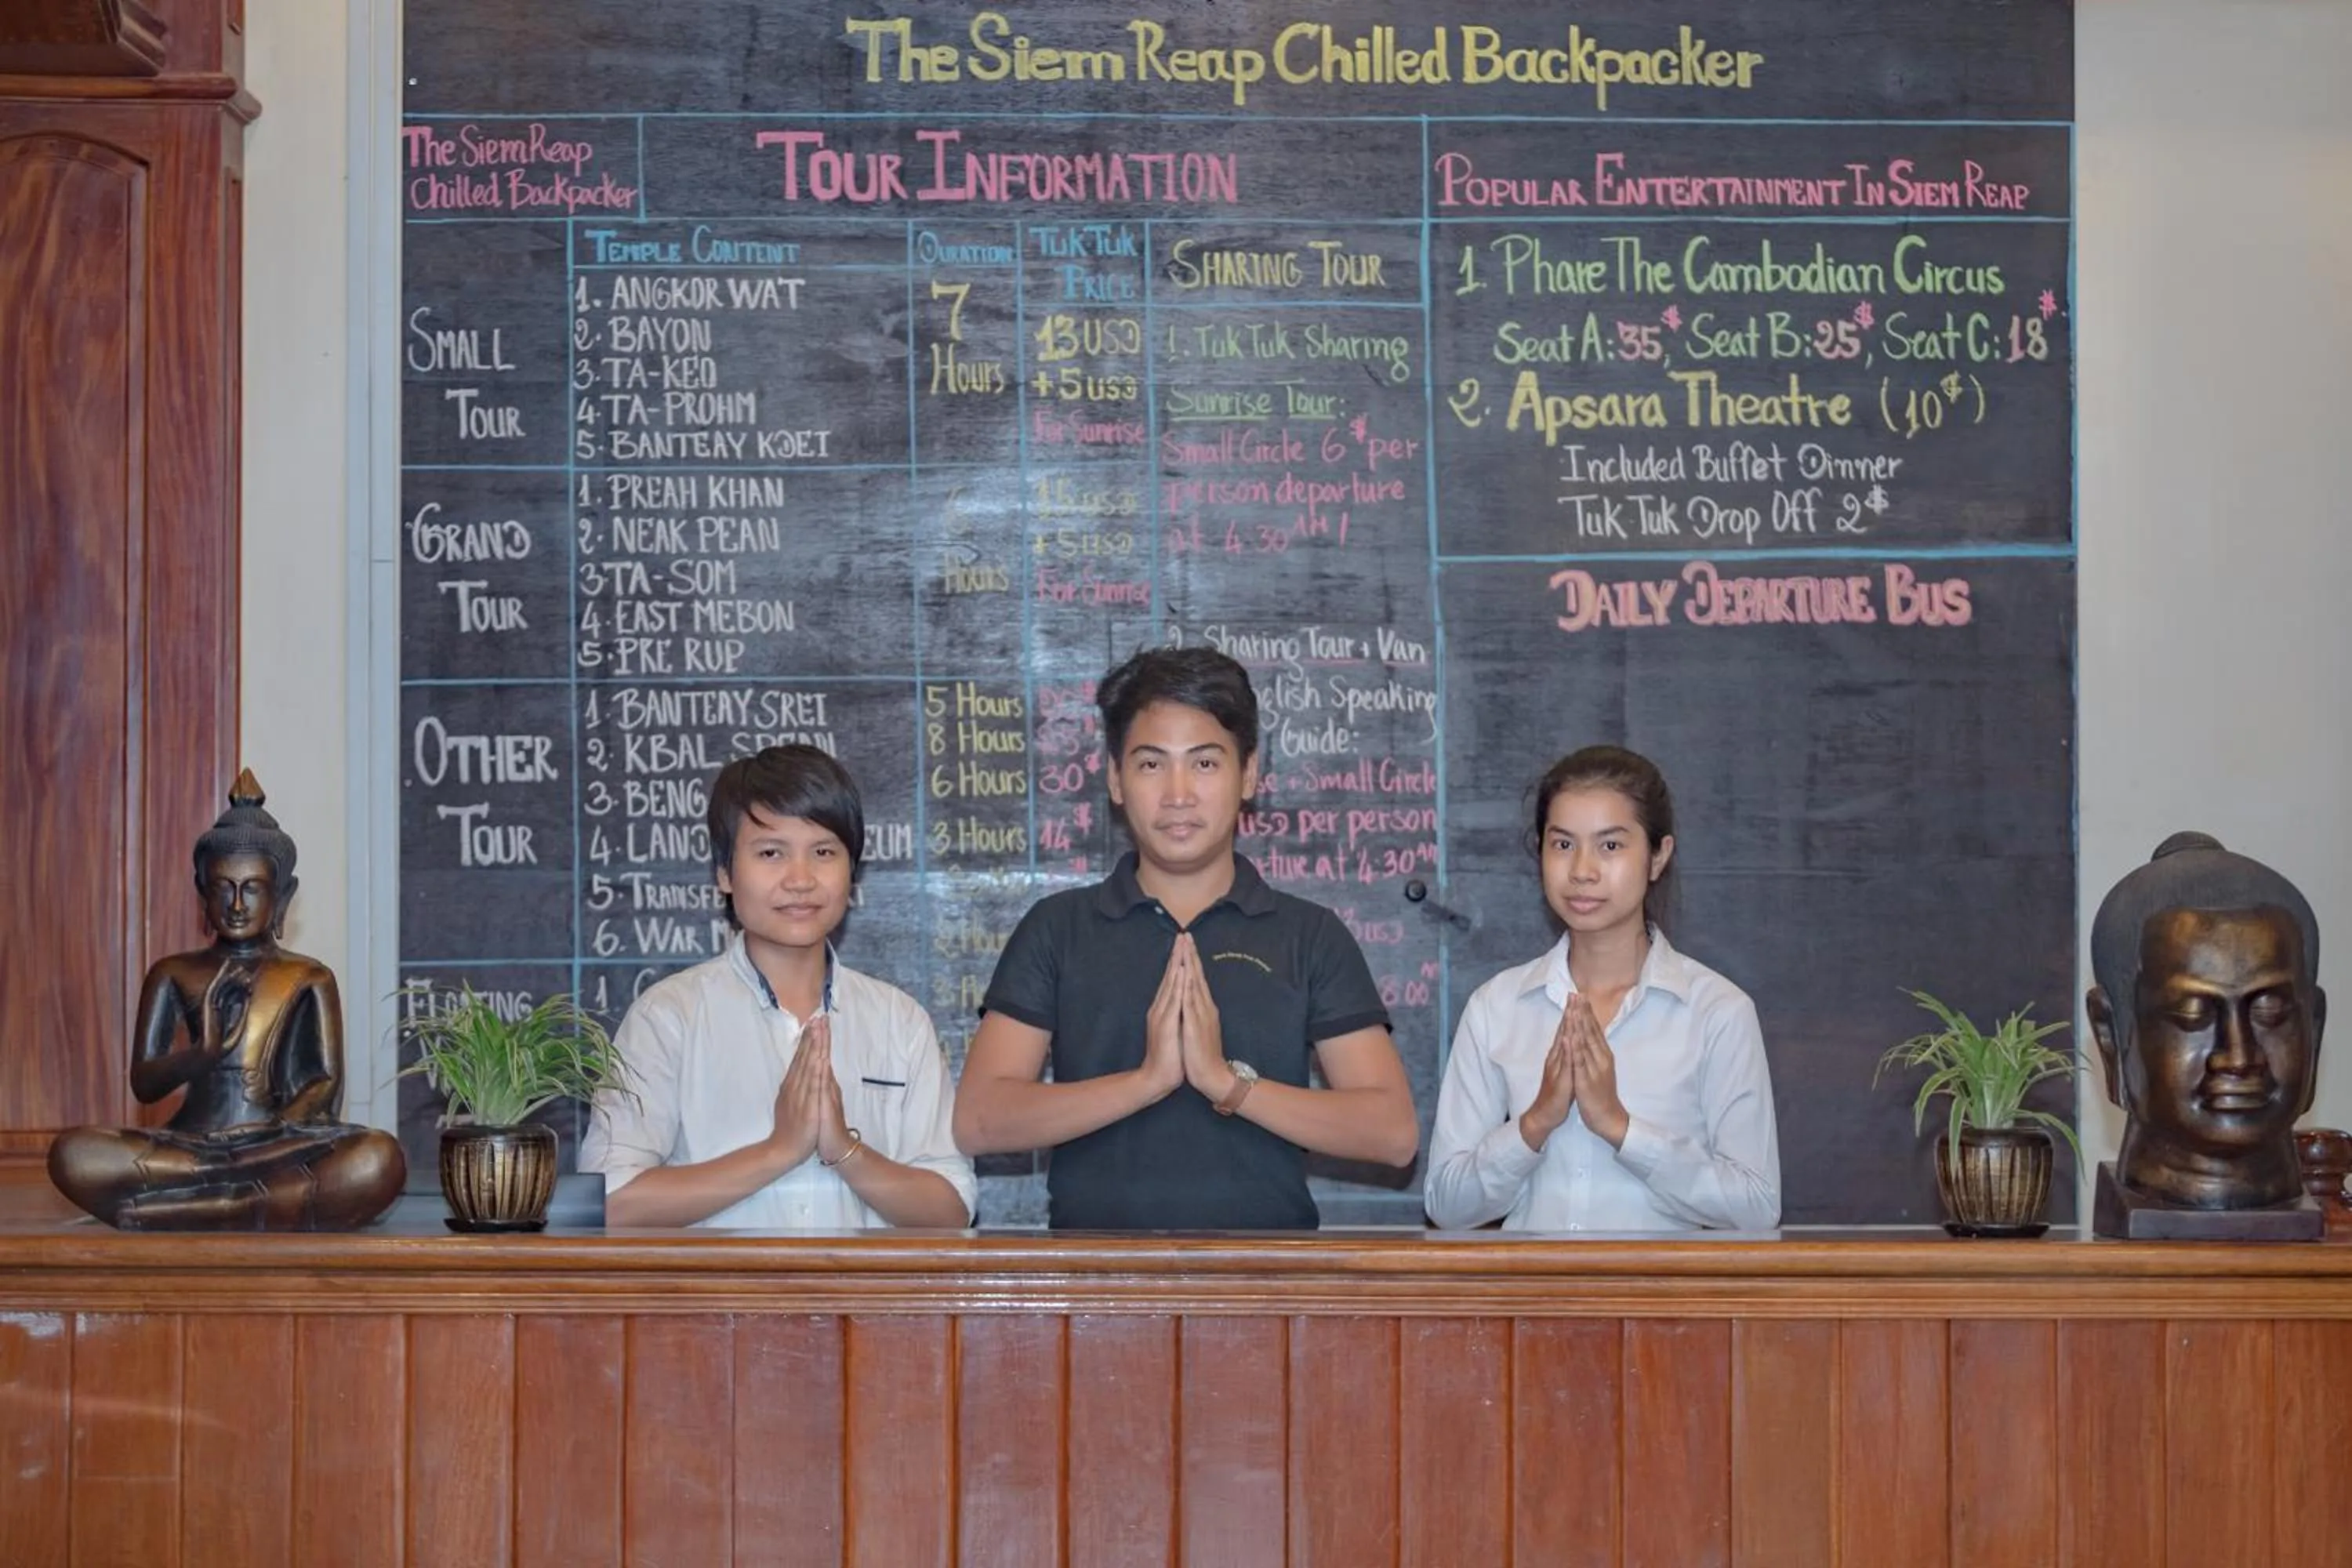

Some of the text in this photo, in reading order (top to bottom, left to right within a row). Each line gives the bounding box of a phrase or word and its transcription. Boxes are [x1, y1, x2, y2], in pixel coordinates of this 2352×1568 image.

[846, 12, 1765, 111] The Siem Reap Chilled Backpacker
[402, 126, 456, 168] The
[756, 129, 1238, 204] TOUR INFORMATION
[410, 169, 637, 214] Chilled Backpacker
[1434, 152, 1589, 208] POPULAR
[1595, 152, 1847, 209] ENTERTAINMENT
[1887, 158, 1960, 209] SIEM
[1963, 159, 2031, 210] REAP
[584, 225, 800, 264] TEMPLE CONTENT
[1169, 238, 1387, 289] SHARING TOUR
[1490, 233, 1607, 296] Phare
[1599, 236, 1677, 294] The
[1683, 234, 1886, 295] Cambodian
[1893, 234, 2007, 295] Circus
[611, 276, 724, 311] ANGKOR
[726, 277, 806, 310] WAT
[930, 279, 971, 341] 7
[408, 307, 516, 372] SMALL
[608, 316, 712, 353] BAYON
[1304, 322, 1410, 382] Sharing
[1493, 320, 1577, 365] Seat
[1686, 312, 1762, 361] Seat
[1882, 310, 1962, 361] Seat
[445, 388, 526, 439] TOUR
[1505, 369, 1669, 448] Apsara
[1667, 369, 1852, 428] Theatre
[608, 430, 747, 460] BANTEAY
[1367, 435, 1419, 471] per
[1559, 439, 1904, 484] Included Buffet Dinner
[605, 473, 698, 510] PREAH
[708, 475, 785, 510] KHAN
[1274, 470, 1406, 518] departure
[612, 517, 688, 554] NEAK
[697, 517, 781, 554] PEAN
[1686, 495, 1762, 546] Drop
[1772, 486, 1823, 534] Off
[437, 579, 529, 633] TOUR
[614, 600, 683, 634] EAST
[691, 600, 796, 636] MEBON
[1547, 560, 1973, 633] DAILY DEPARTURE BUS
[613, 637, 673, 676] PRE
[684, 638, 746, 673] RUP
[1377, 626, 1426, 663] Van
[612, 688, 755, 729] BANTEAY
[925, 685, 949, 718] 5
[414, 716, 560, 786] OTHER
[622, 732, 724, 775] KBAL
[927, 721, 946, 757] 8
[931, 764, 954, 799] 6
[437, 801, 539, 866] TOUR
[1298, 809, 1340, 844] per
[1347, 808, 1437, 851] person
[633, 916, 705, 956] WAR
